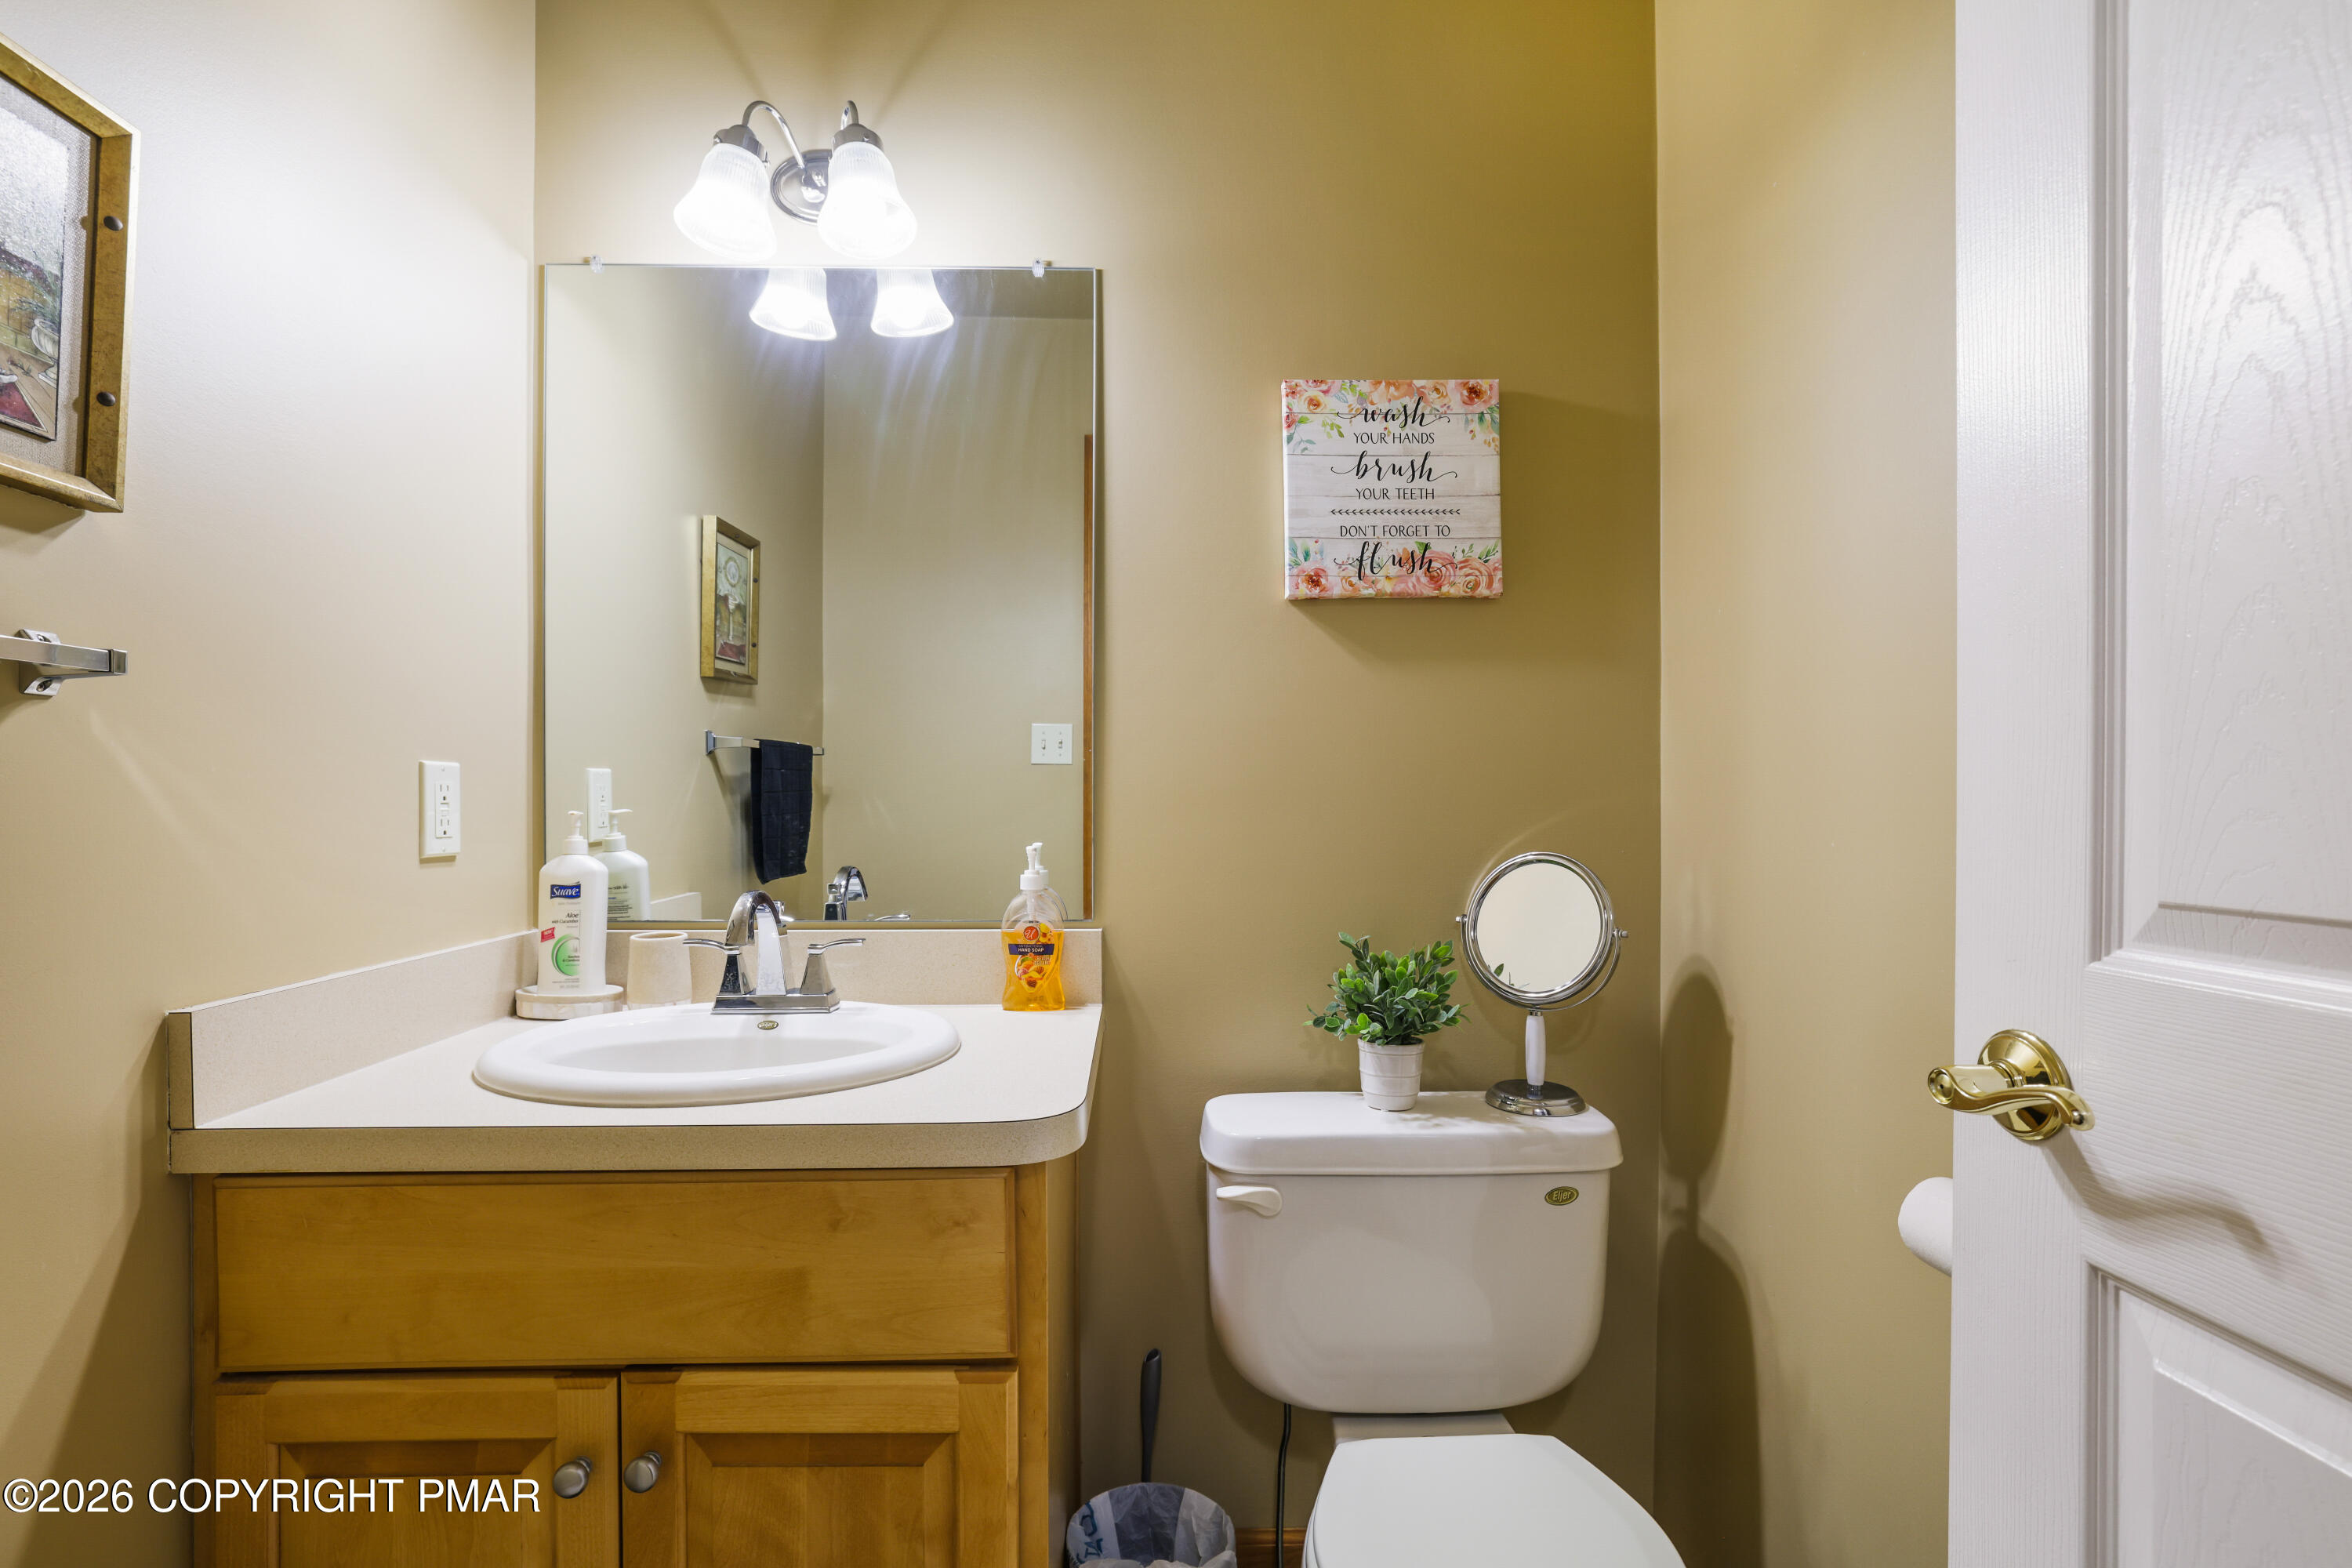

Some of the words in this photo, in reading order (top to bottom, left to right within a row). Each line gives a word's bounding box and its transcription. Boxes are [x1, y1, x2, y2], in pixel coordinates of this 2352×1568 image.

[1337, 395, 1450, 429] wash
[1353, 432, 1387, 445] YOUR
[1392, 432, 1436, 445] HANDS
[1330, 450, 1458, 484] brush
[1356, 488, 1391, 500] YOUR
[1395, 488, 1435, 500] TEETH
[1340, 524, 1377, 538] DON'T
[1382, 524, 1429, 538] FORGET
[1435, 524, 1450, 538] TO
[1334, 540, 1458, 582] flush
[551, 886, 579, 897] Suave
